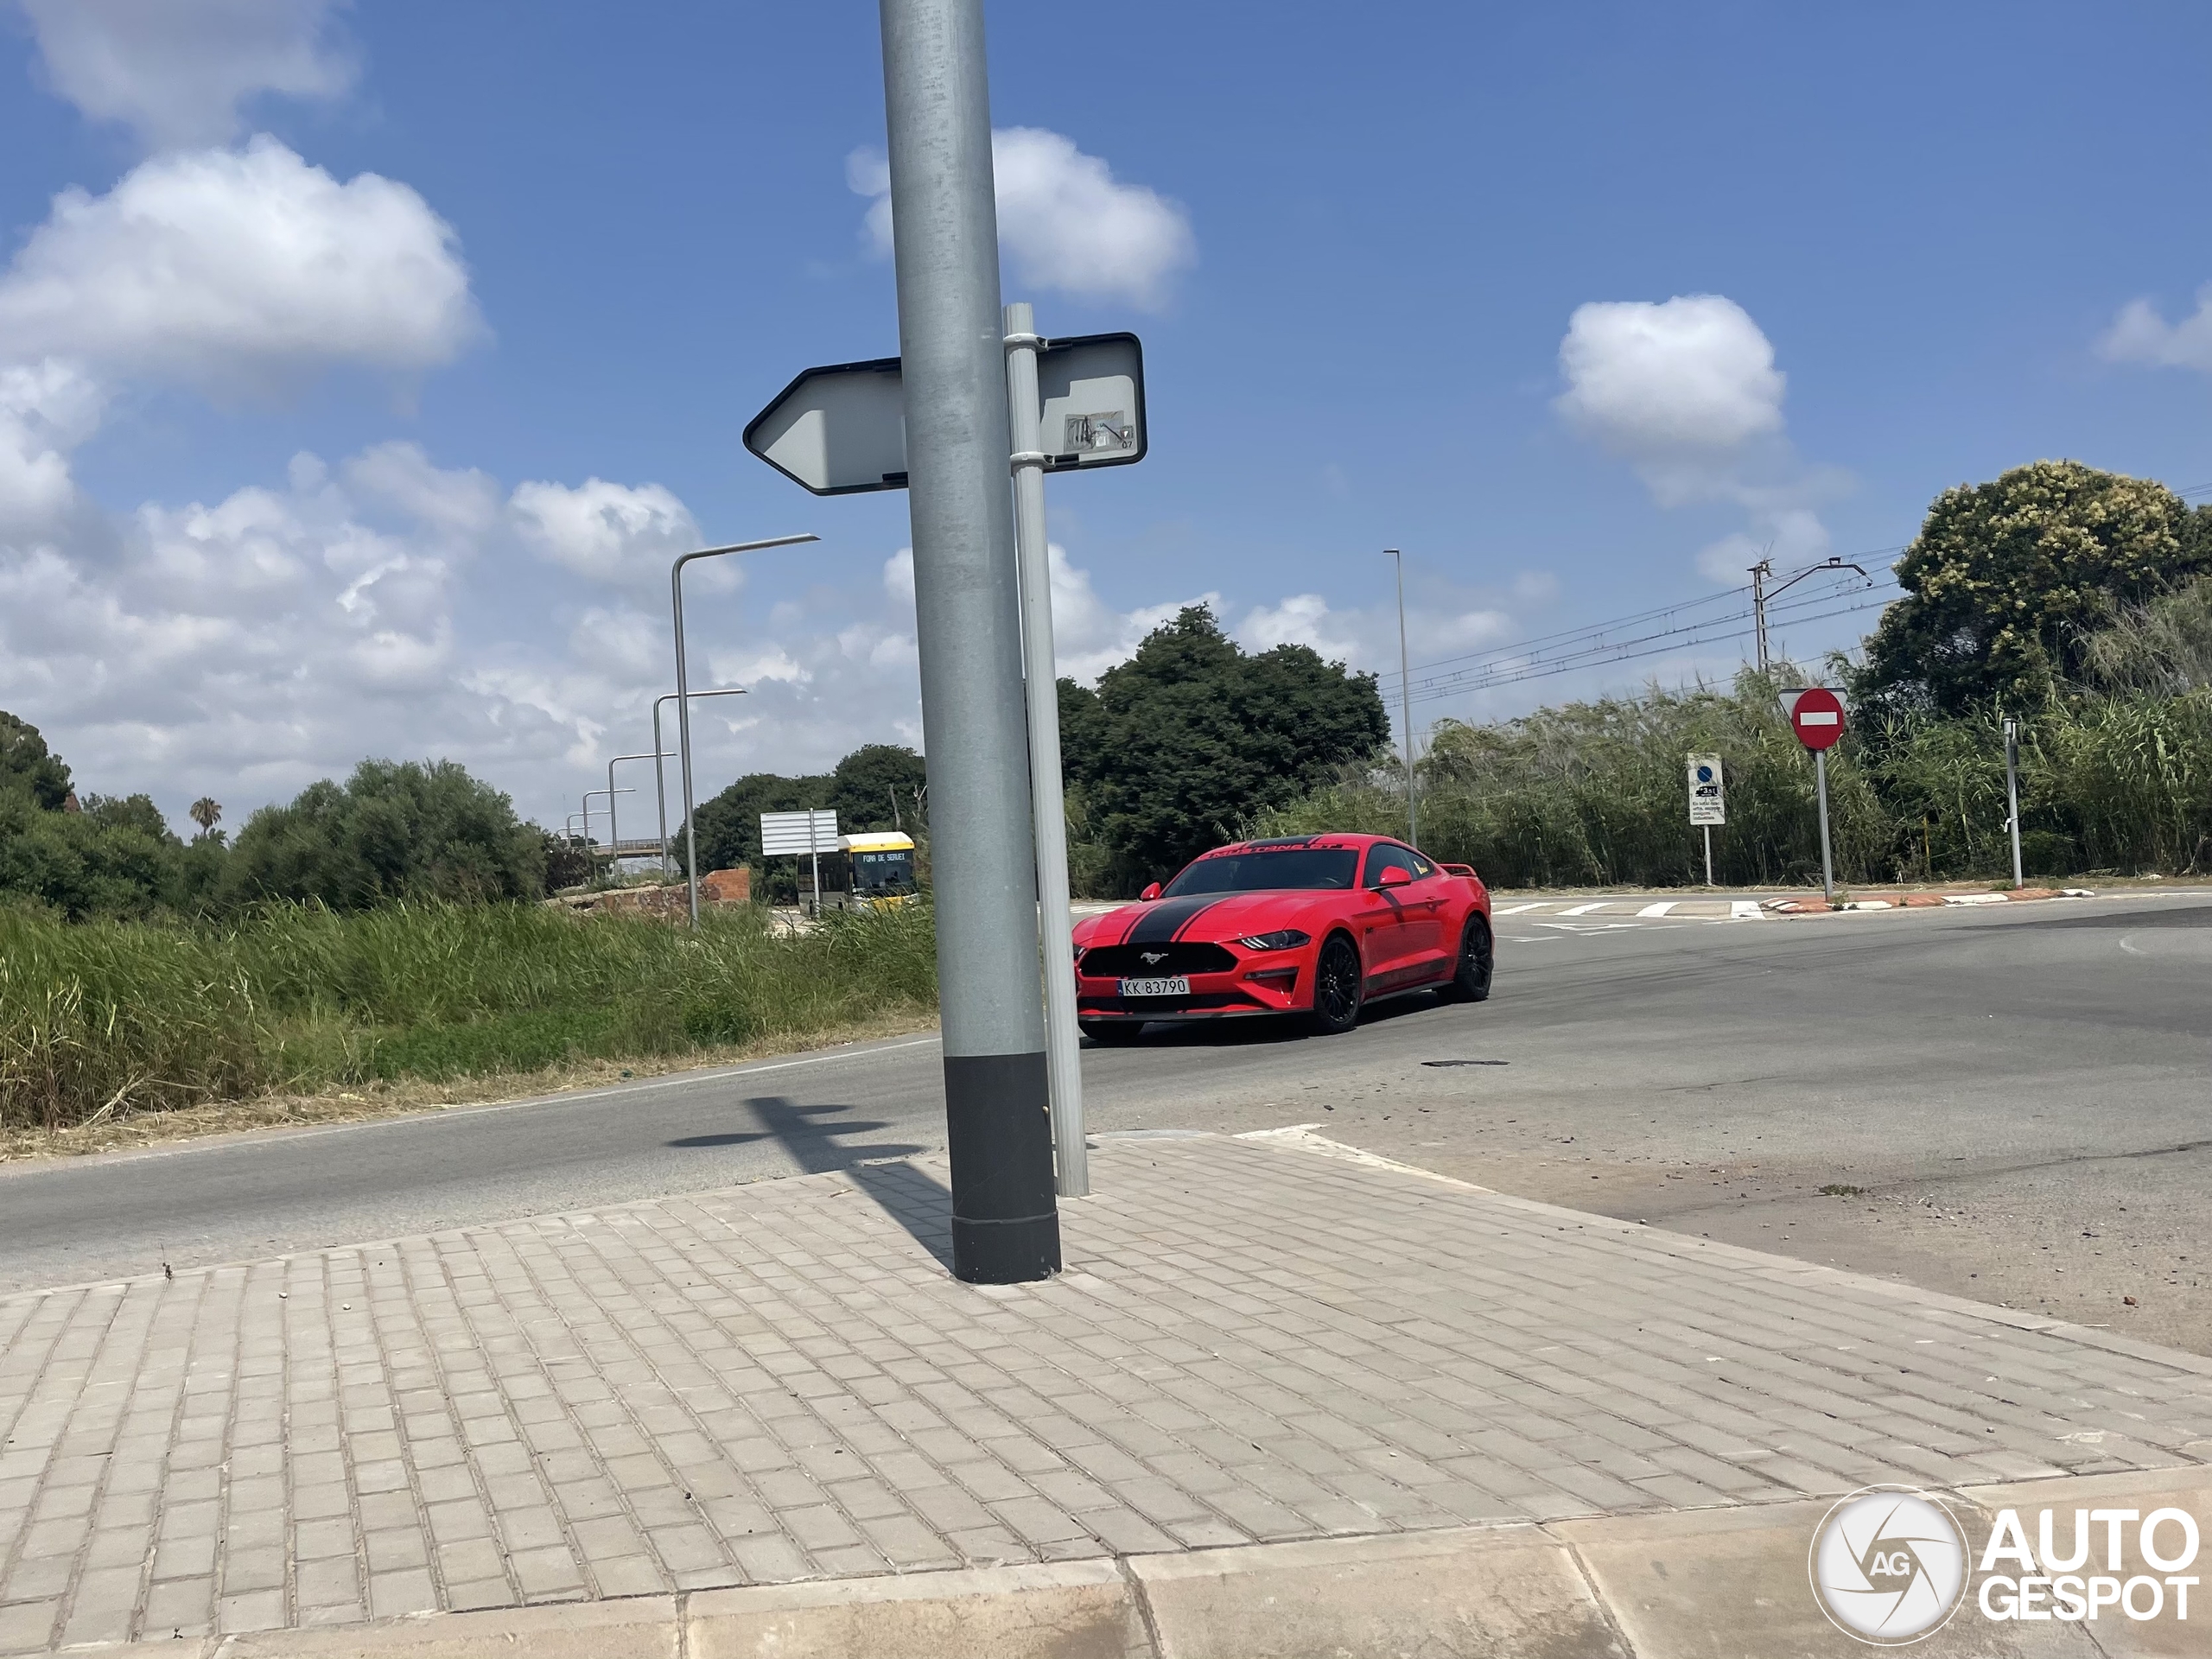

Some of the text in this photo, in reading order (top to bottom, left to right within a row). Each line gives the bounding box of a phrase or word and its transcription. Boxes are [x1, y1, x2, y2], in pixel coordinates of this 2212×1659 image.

[877, 854, 886, 862] DE
[1124, 980, 1185, 995] KK 83790
